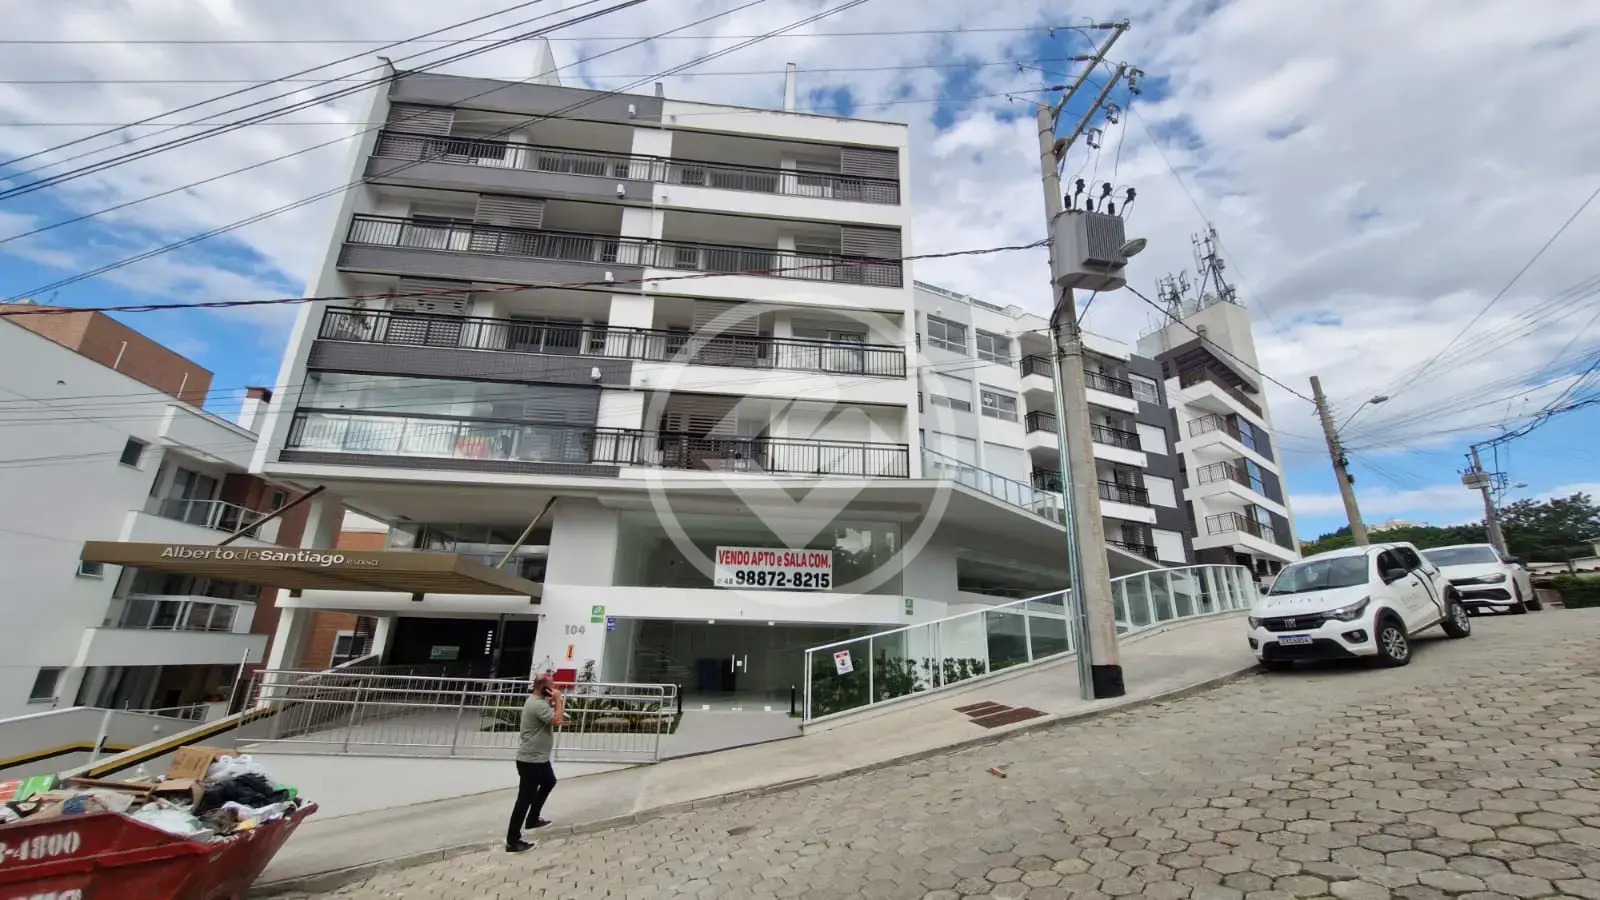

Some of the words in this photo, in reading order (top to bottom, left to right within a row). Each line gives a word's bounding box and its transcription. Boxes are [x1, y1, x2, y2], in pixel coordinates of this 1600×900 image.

[718, 549, 750, 565] VENDO
[751, 551, 775, 566] APTO
[776, 555, 782, 566] e
[784, 552, 807, 567] SALA
[808, 553, 831, 568] COM.
[735, 570, 830, 588] 98872-8215
[564, 624, 586, 635] 104
